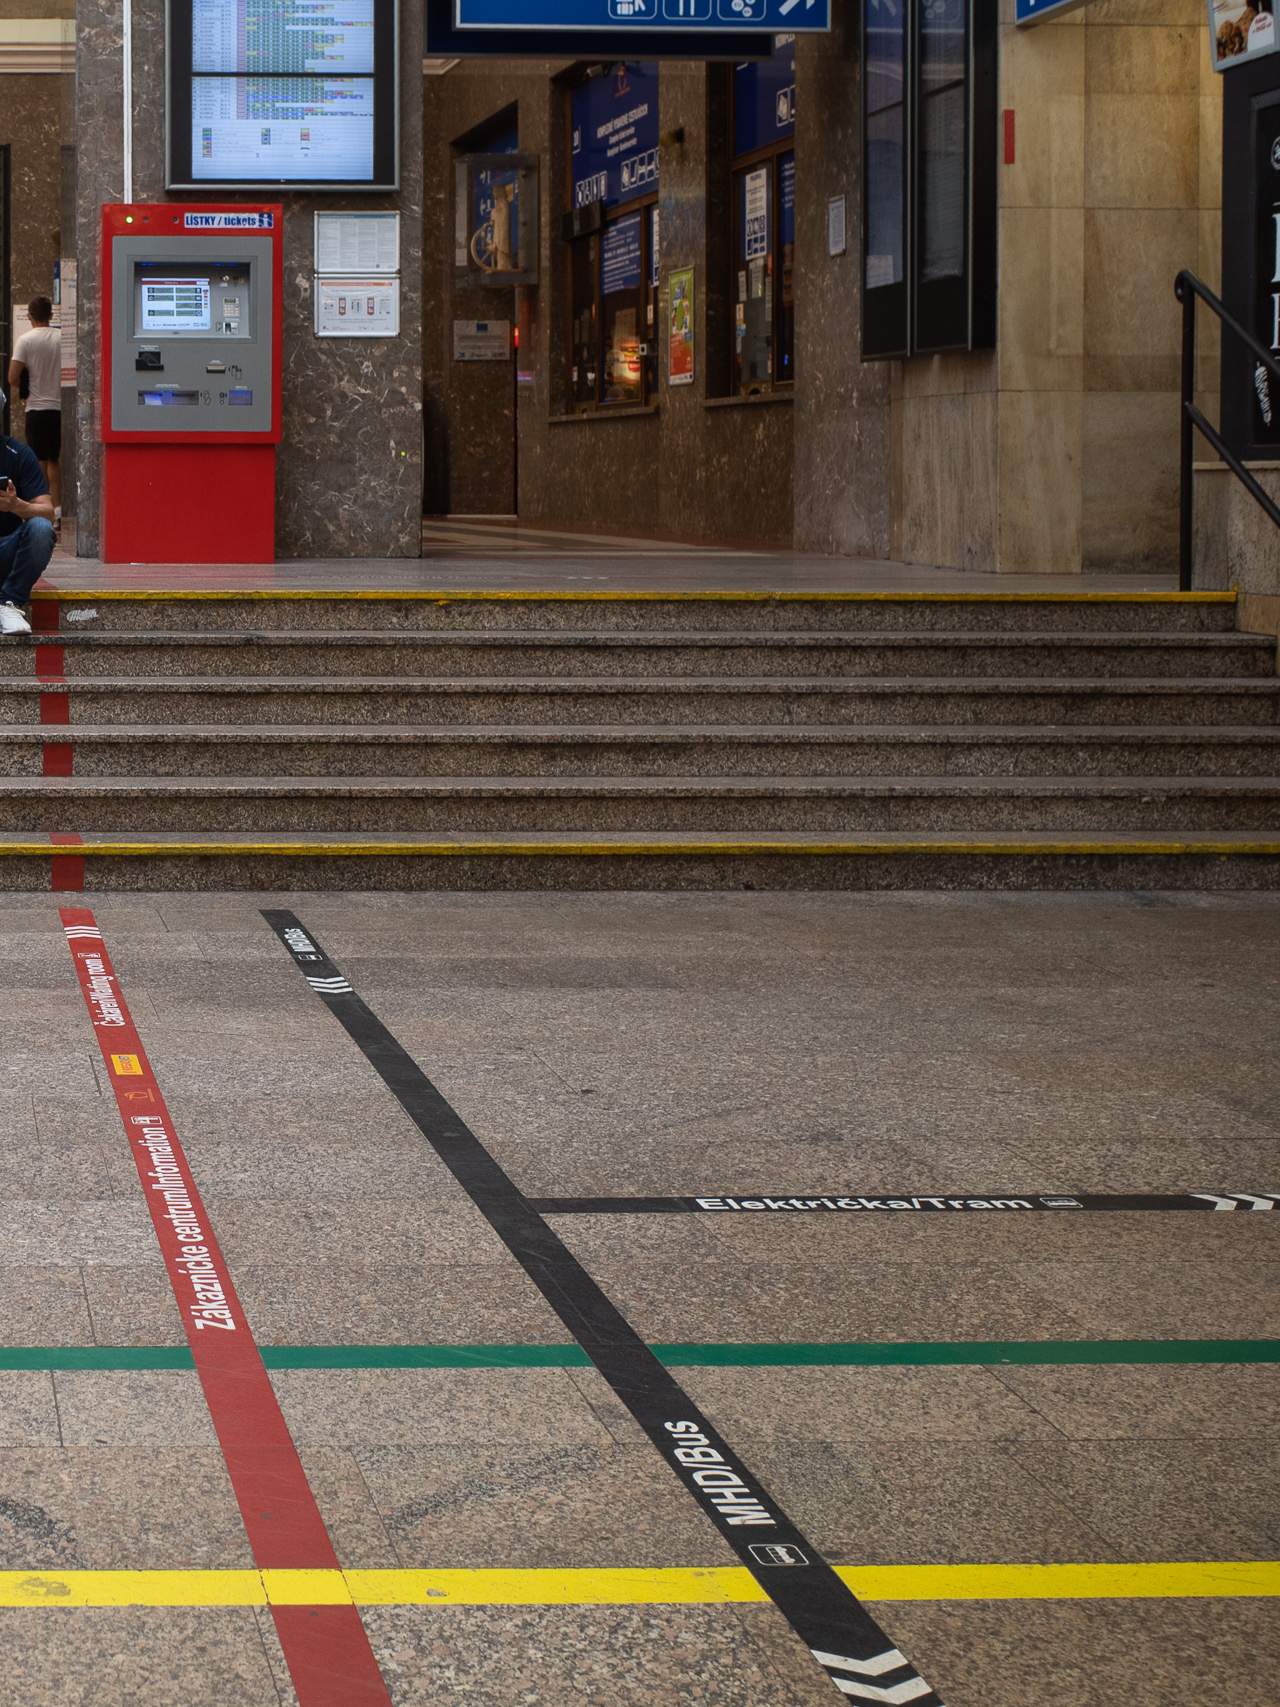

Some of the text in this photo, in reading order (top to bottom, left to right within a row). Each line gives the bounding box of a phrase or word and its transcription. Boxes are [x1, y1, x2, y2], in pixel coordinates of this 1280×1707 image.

[186, 214, 216, 225] LÍSTKY
[224, 216, 256, 226] tickets
[85, 959, 106, 975] room
[696, 1197, 1033, 1210] Električka/Tram
[138, 1127, 236, 1330] Zákaznícke centrum/Information
[664, 1421, 776, 1526] MHD/Bus
